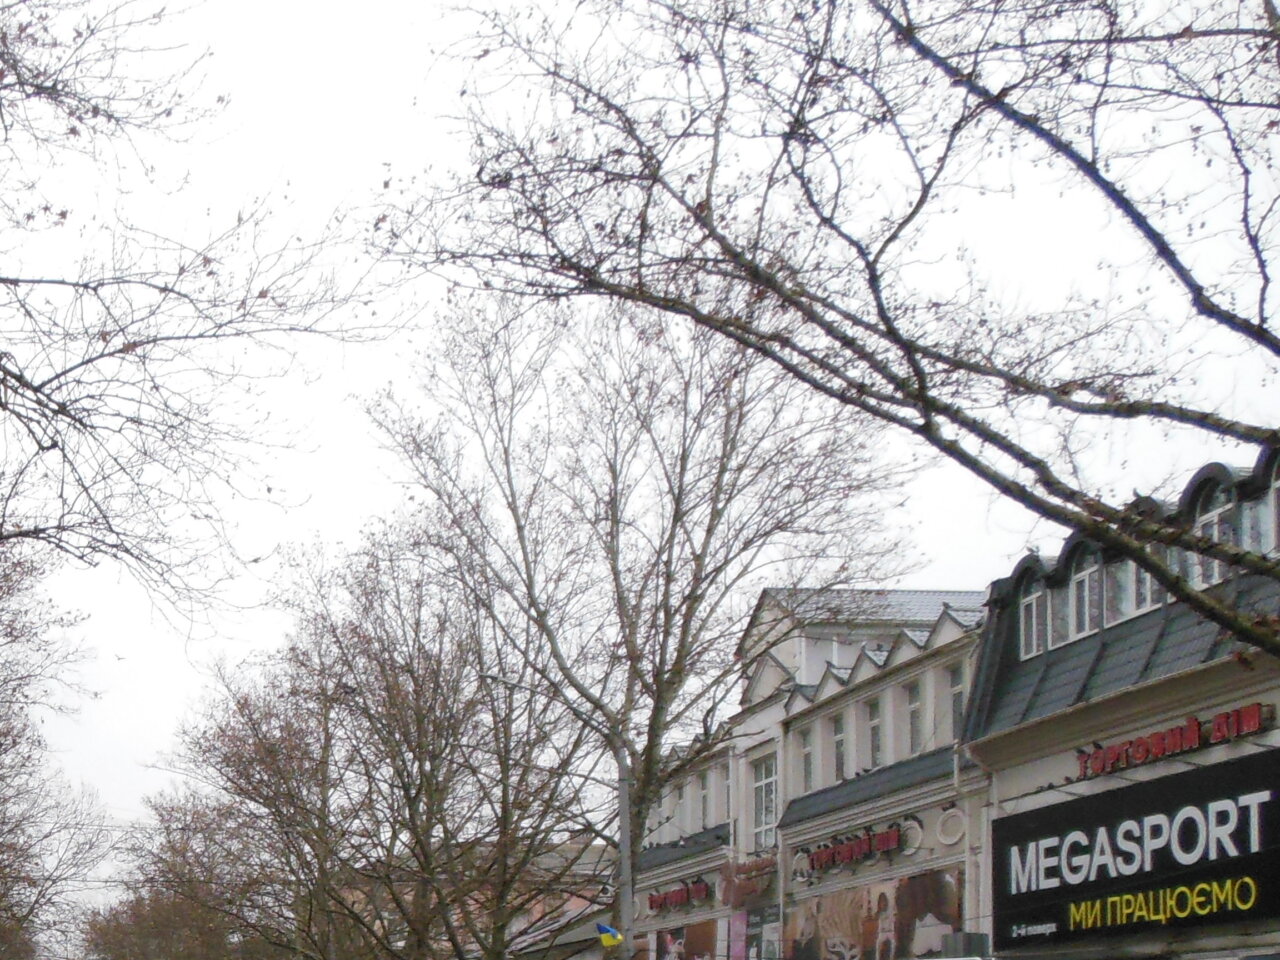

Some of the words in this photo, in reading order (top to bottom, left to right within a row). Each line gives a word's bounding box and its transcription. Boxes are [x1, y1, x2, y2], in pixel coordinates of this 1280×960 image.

[1010, 790, 1271, 896] MEGASPORT
[1069, 899, 1102, 931] МИ
[1106, 876, 1257, 925] ПРАЦЮЄМО
